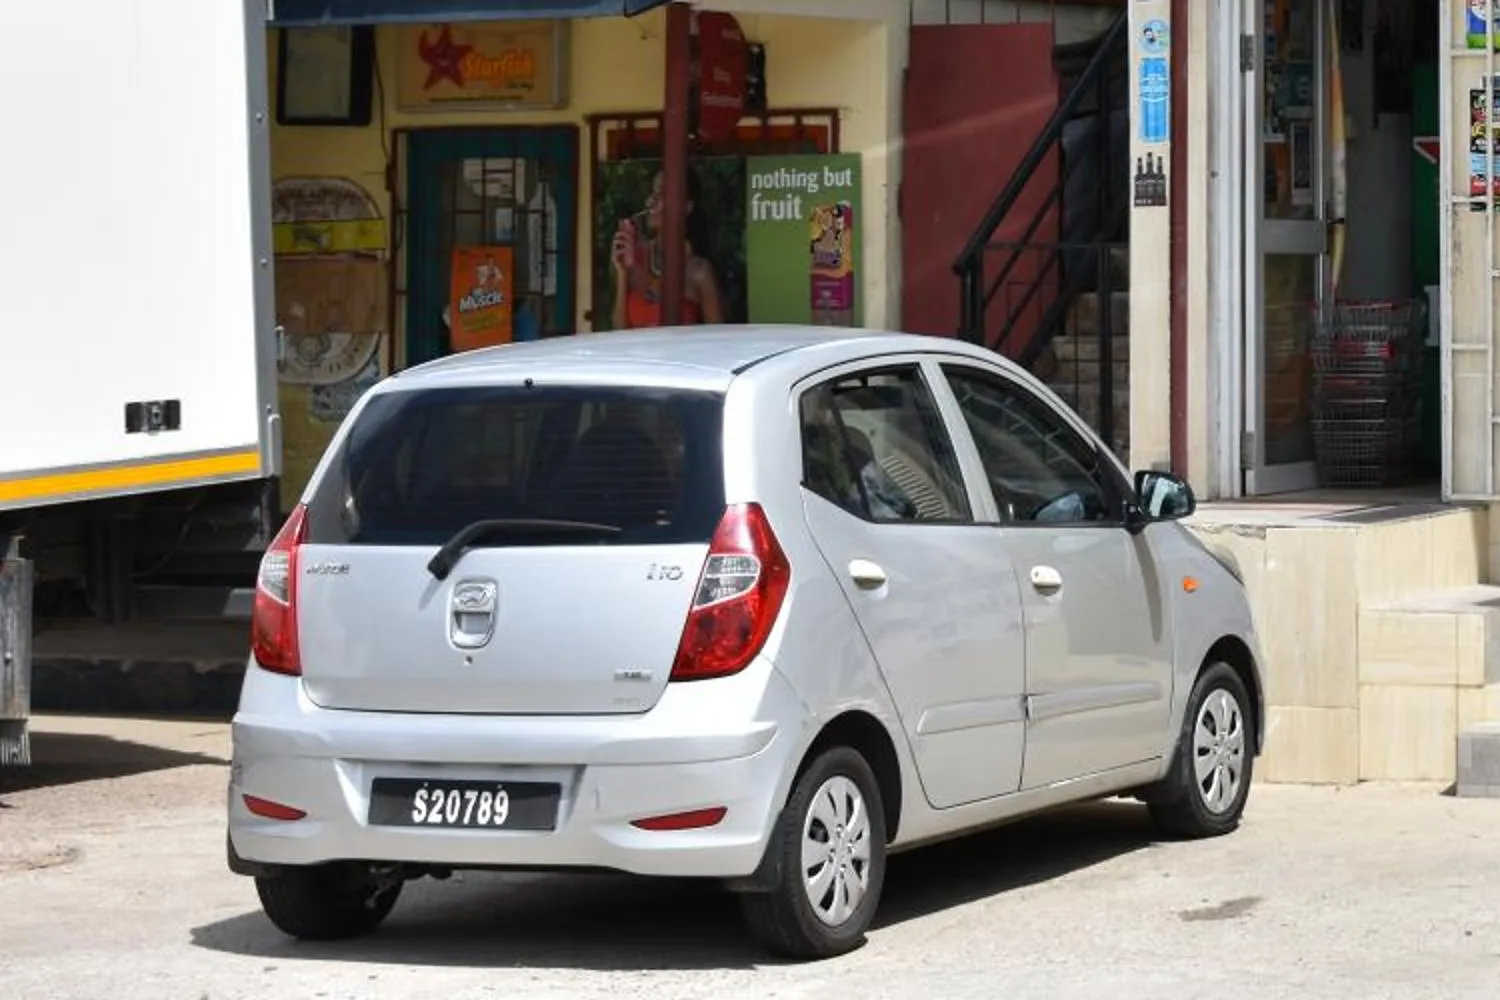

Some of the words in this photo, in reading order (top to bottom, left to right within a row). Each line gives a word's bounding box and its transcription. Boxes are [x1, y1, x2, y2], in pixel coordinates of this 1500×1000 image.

[751, 168, 820, 193] nothing
[823, 166, 853, 187] but
[751, 192, 803, 221] fruit
[411, 787, 509, 825] S20789
